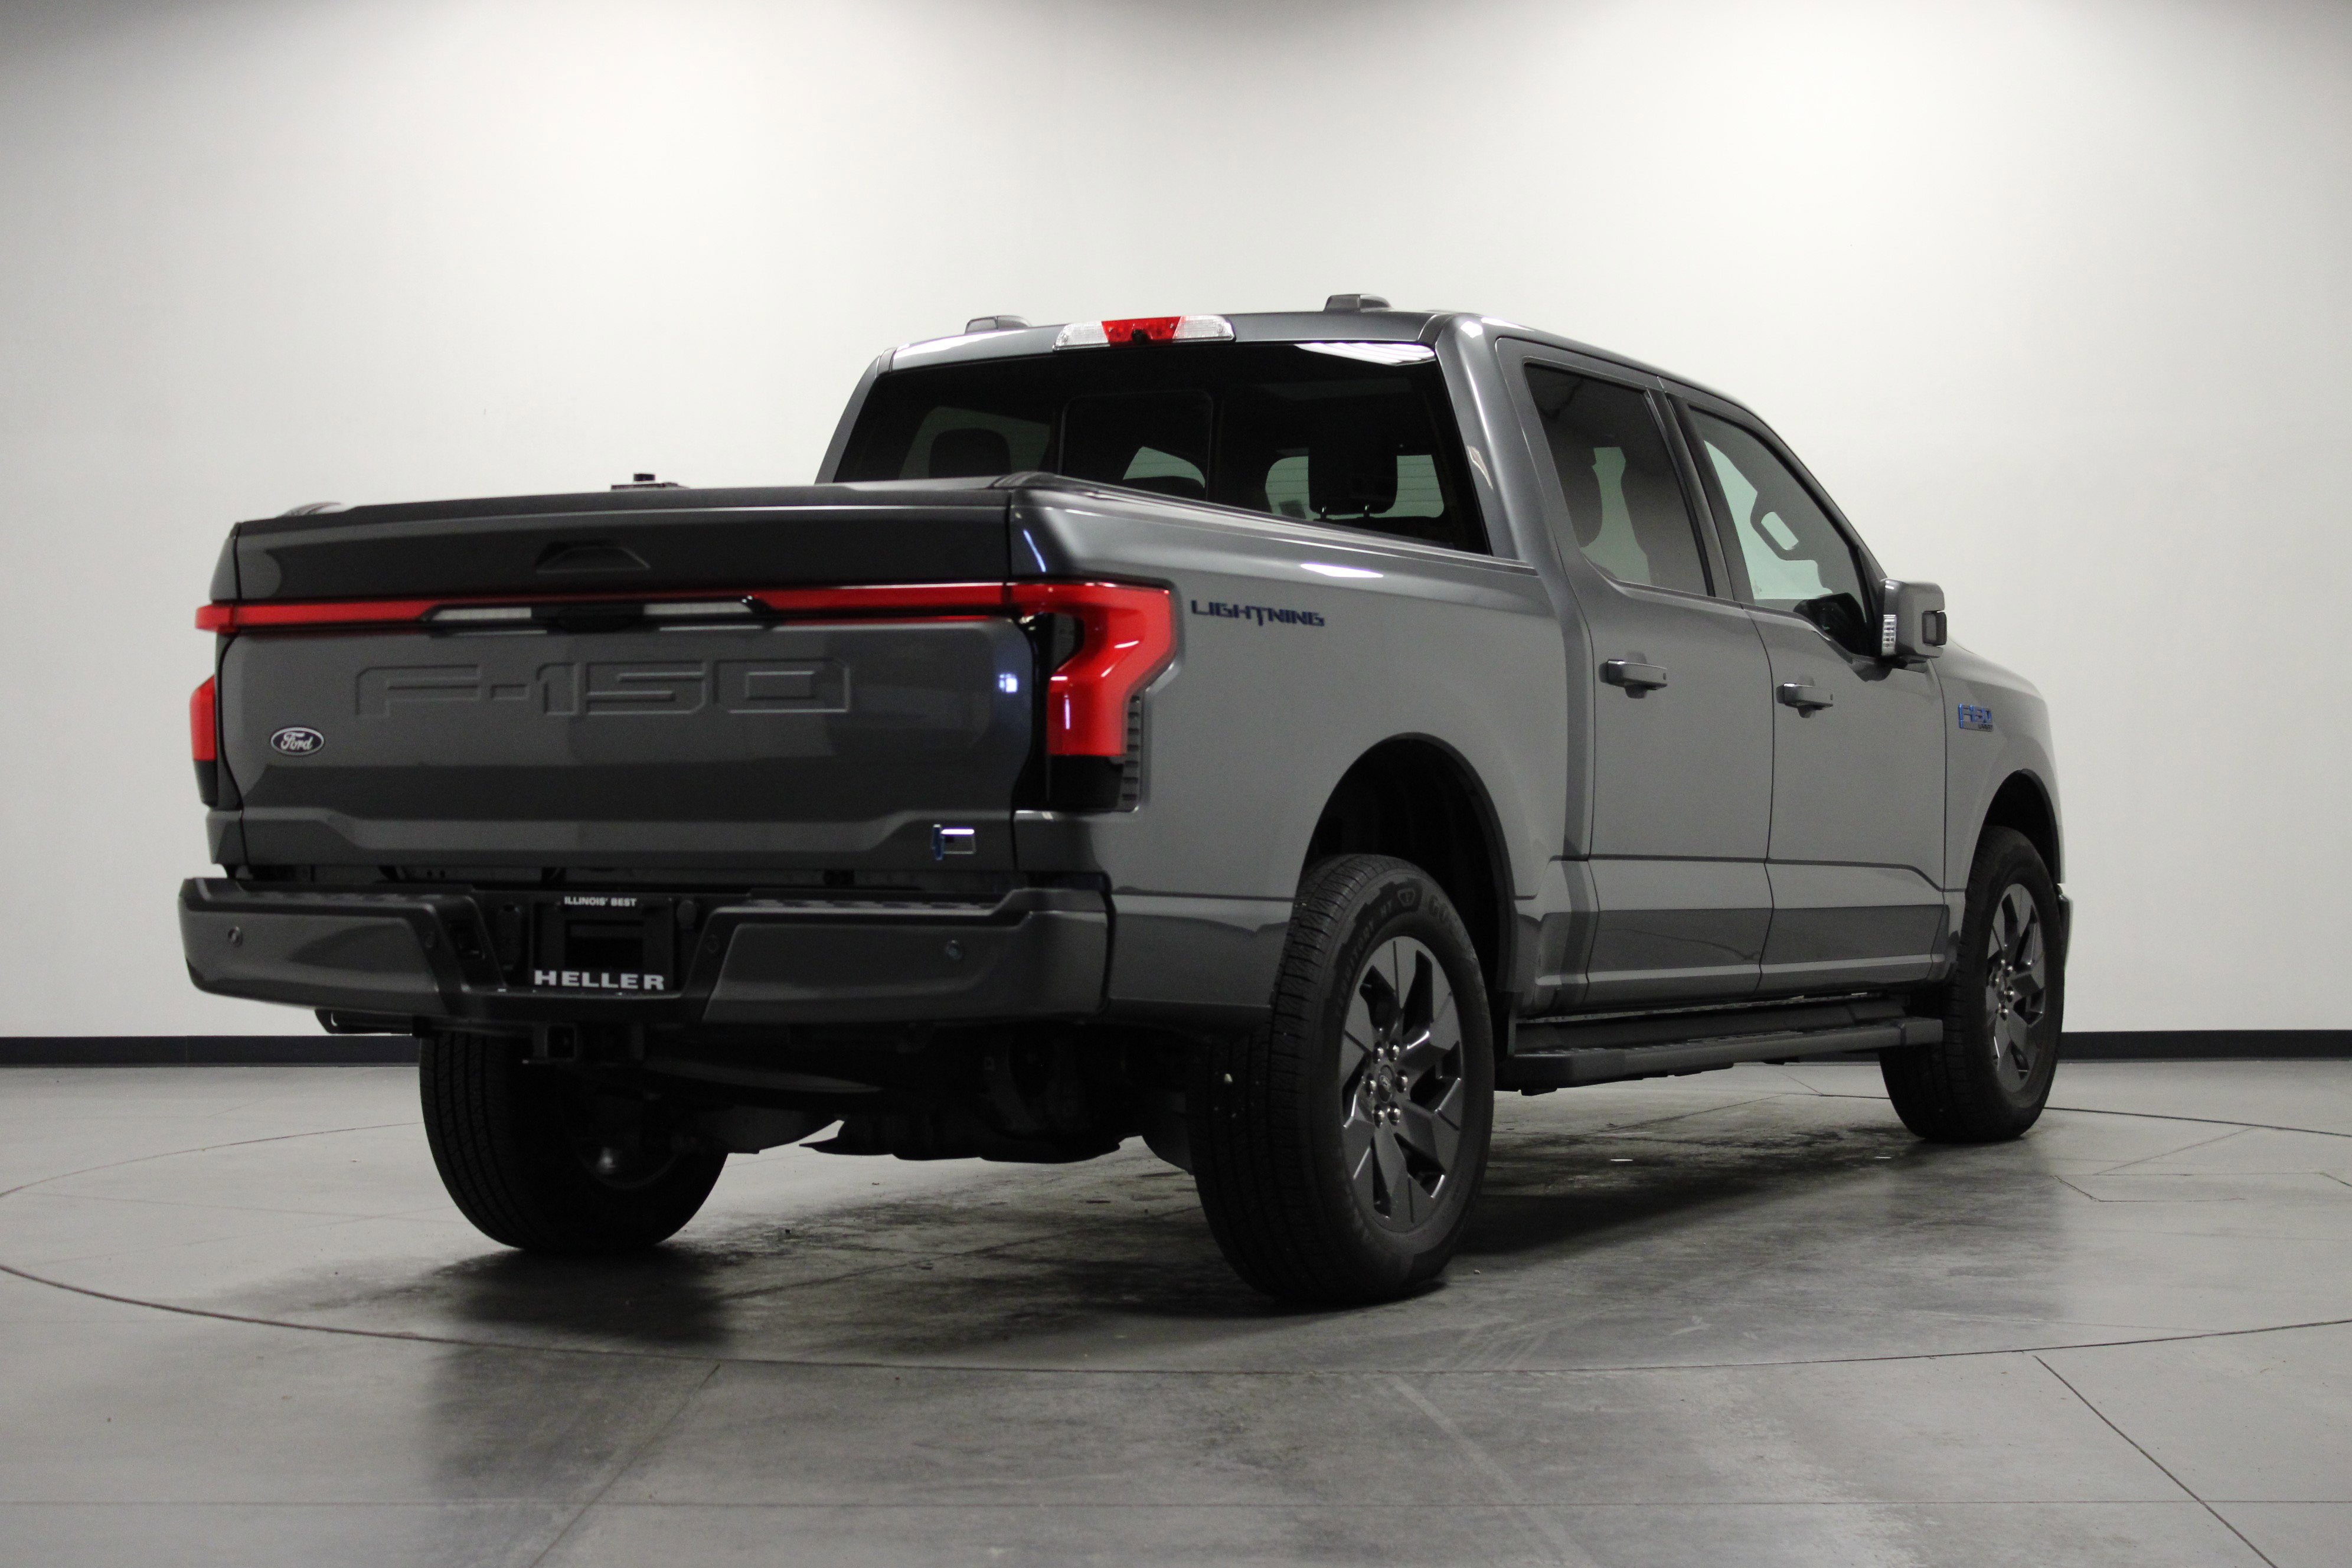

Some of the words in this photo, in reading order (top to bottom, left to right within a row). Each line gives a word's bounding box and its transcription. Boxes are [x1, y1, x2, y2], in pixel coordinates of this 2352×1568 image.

[1191, 600, 1325, 626] LIGHTNING
[356, 658, 851, 716] F-150
[280, 731, 313, 750] Ford
[610, 897, 637, 907] BEST
[534, 969, 664, 991] HELLER
